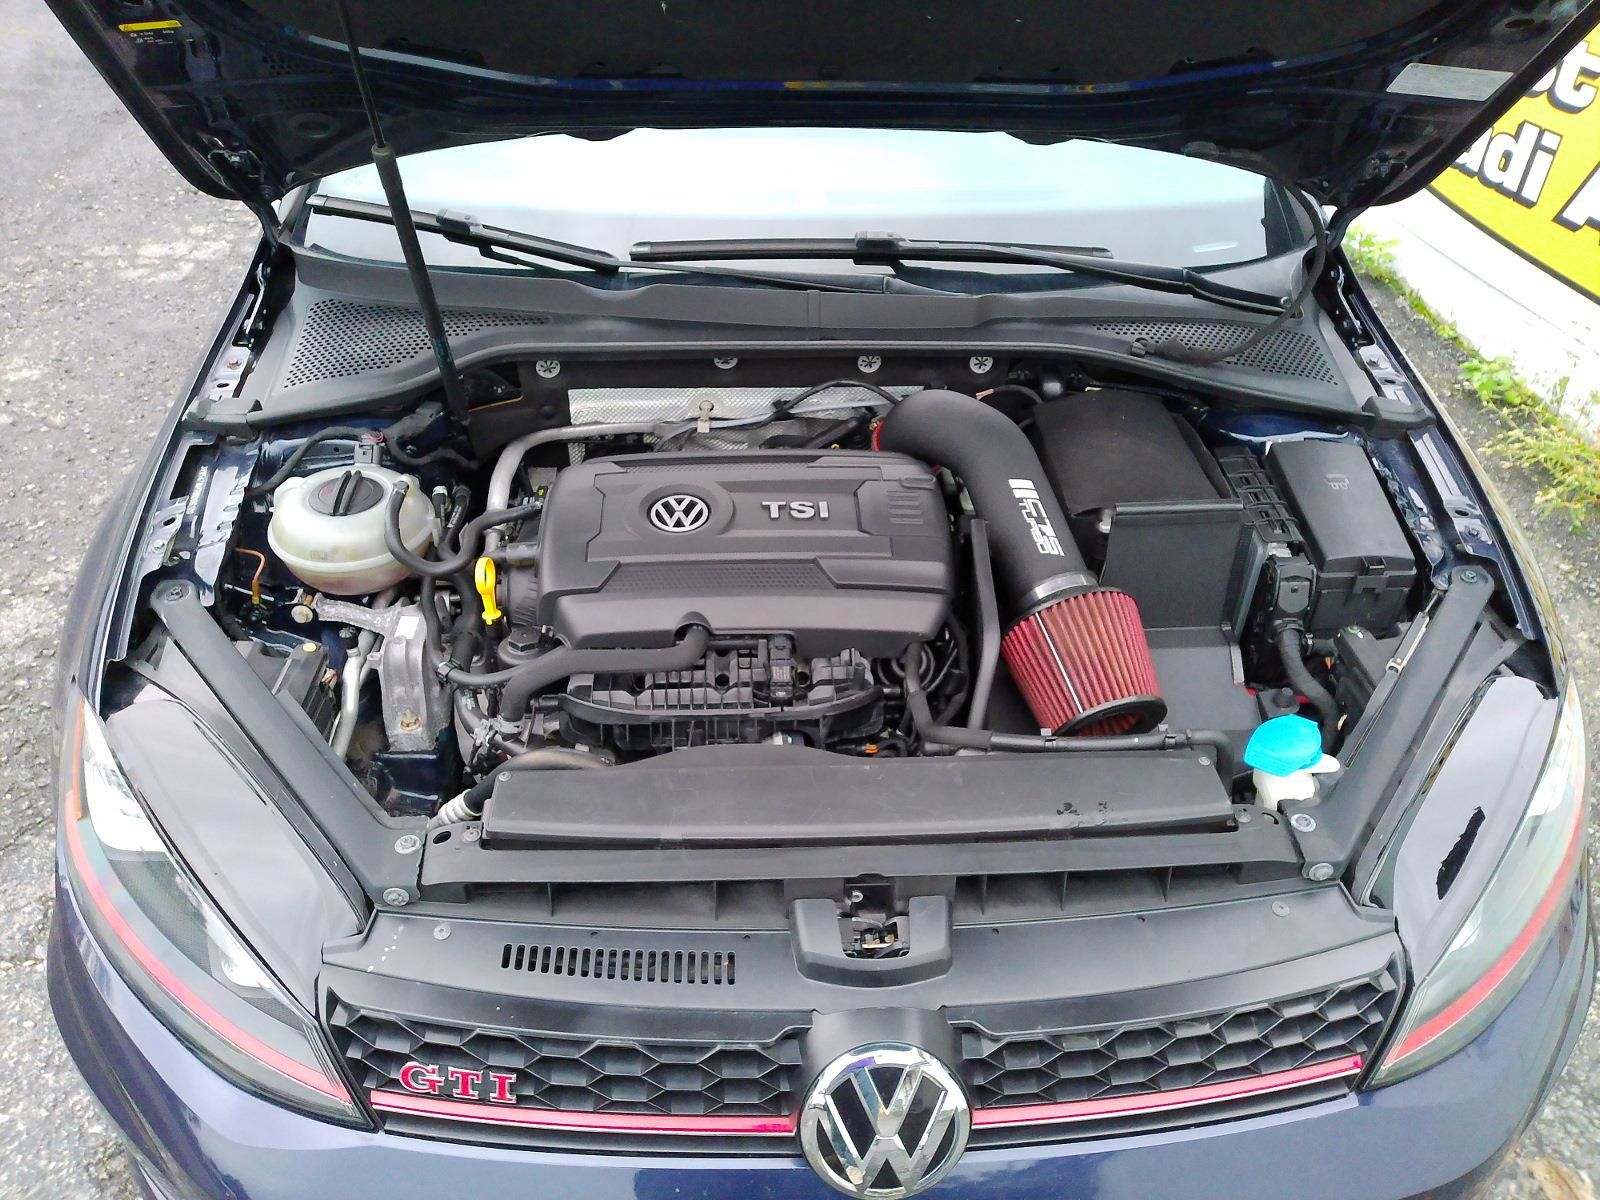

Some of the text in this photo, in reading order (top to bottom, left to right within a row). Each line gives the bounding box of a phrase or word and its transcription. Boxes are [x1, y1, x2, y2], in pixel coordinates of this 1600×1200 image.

[1449, 121, 1561, 208] udi
[762, 501, 829, 519] TSI
[400, 1061, 517, 1103] GTI
